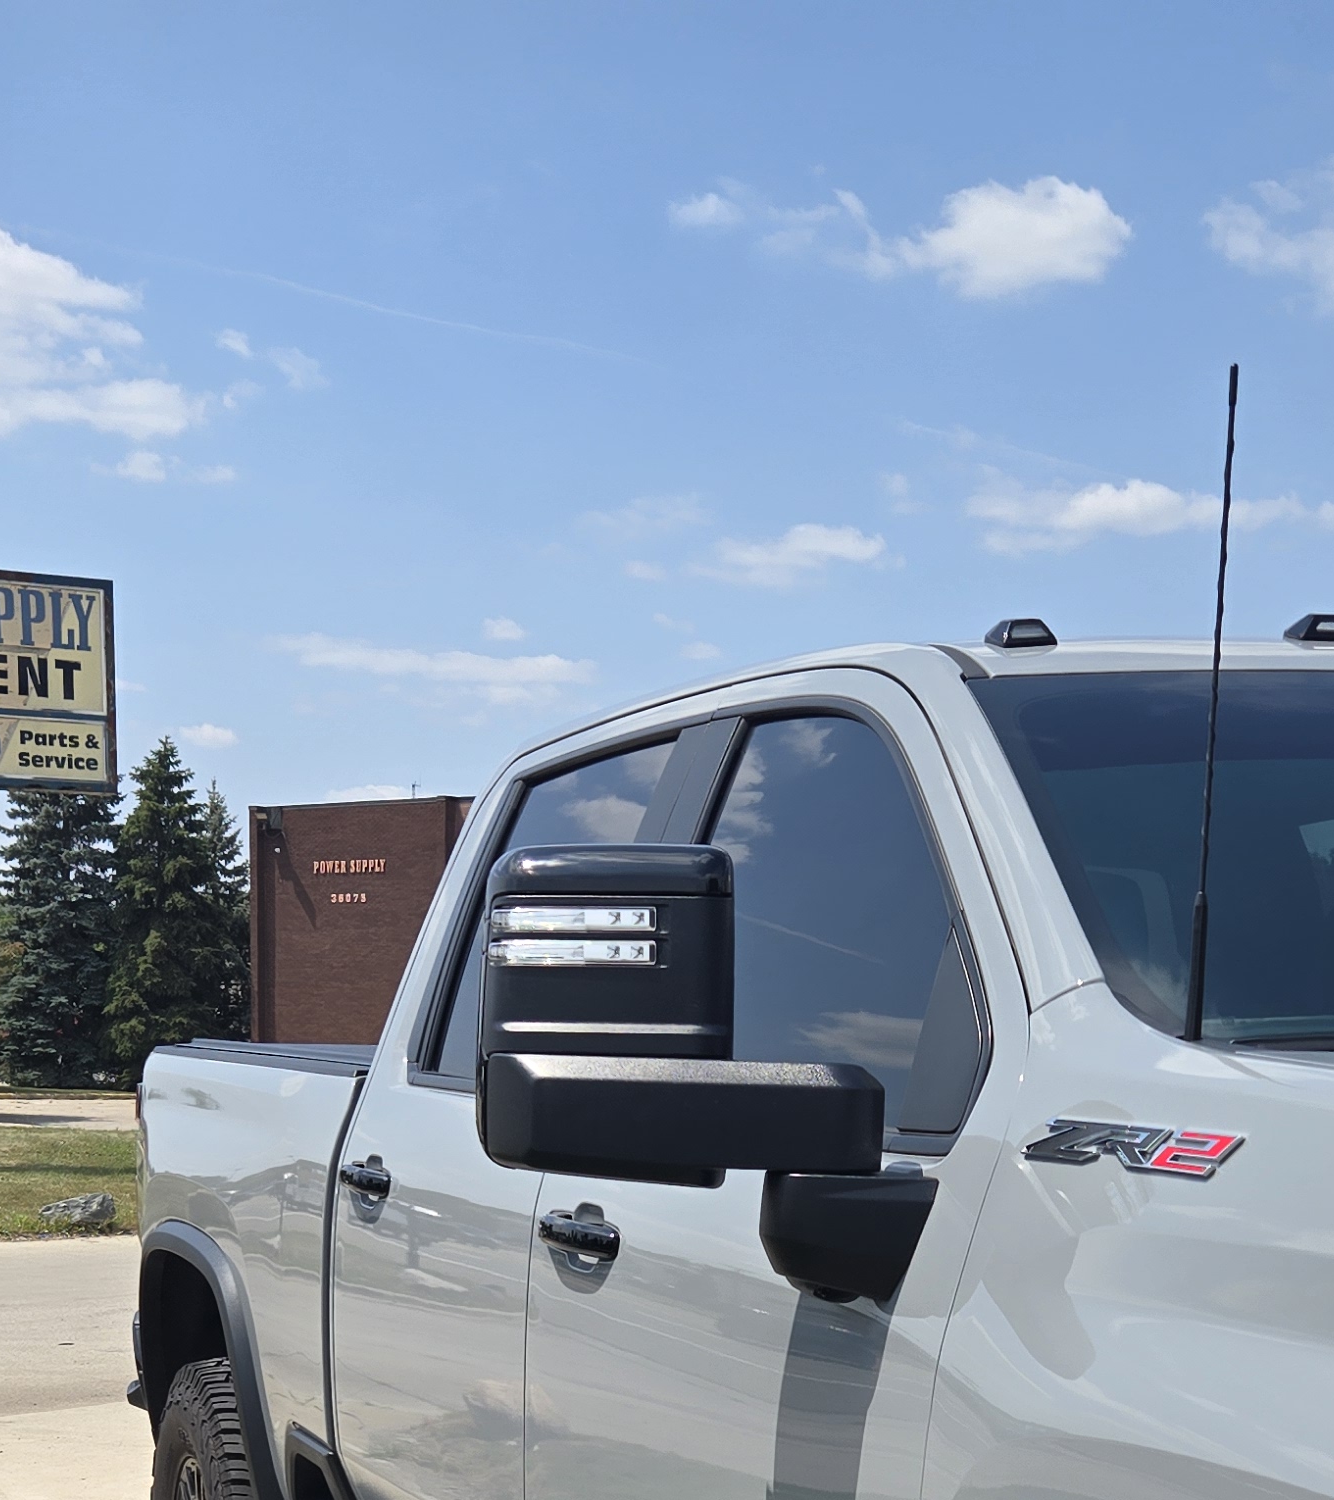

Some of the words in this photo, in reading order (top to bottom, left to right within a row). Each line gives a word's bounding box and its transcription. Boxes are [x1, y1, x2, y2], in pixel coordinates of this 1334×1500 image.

[19, 730, 79, 748] Parts
[85, 734, 100, 749] &
[18, 752, 99, 770] Service
[313, 860, 347, 874] POWER
[350, 859, 386, 873] SUPPLY
[330, 893, 367, 903] 36075
[1020, 1115, 1249, 1182] ZR2
